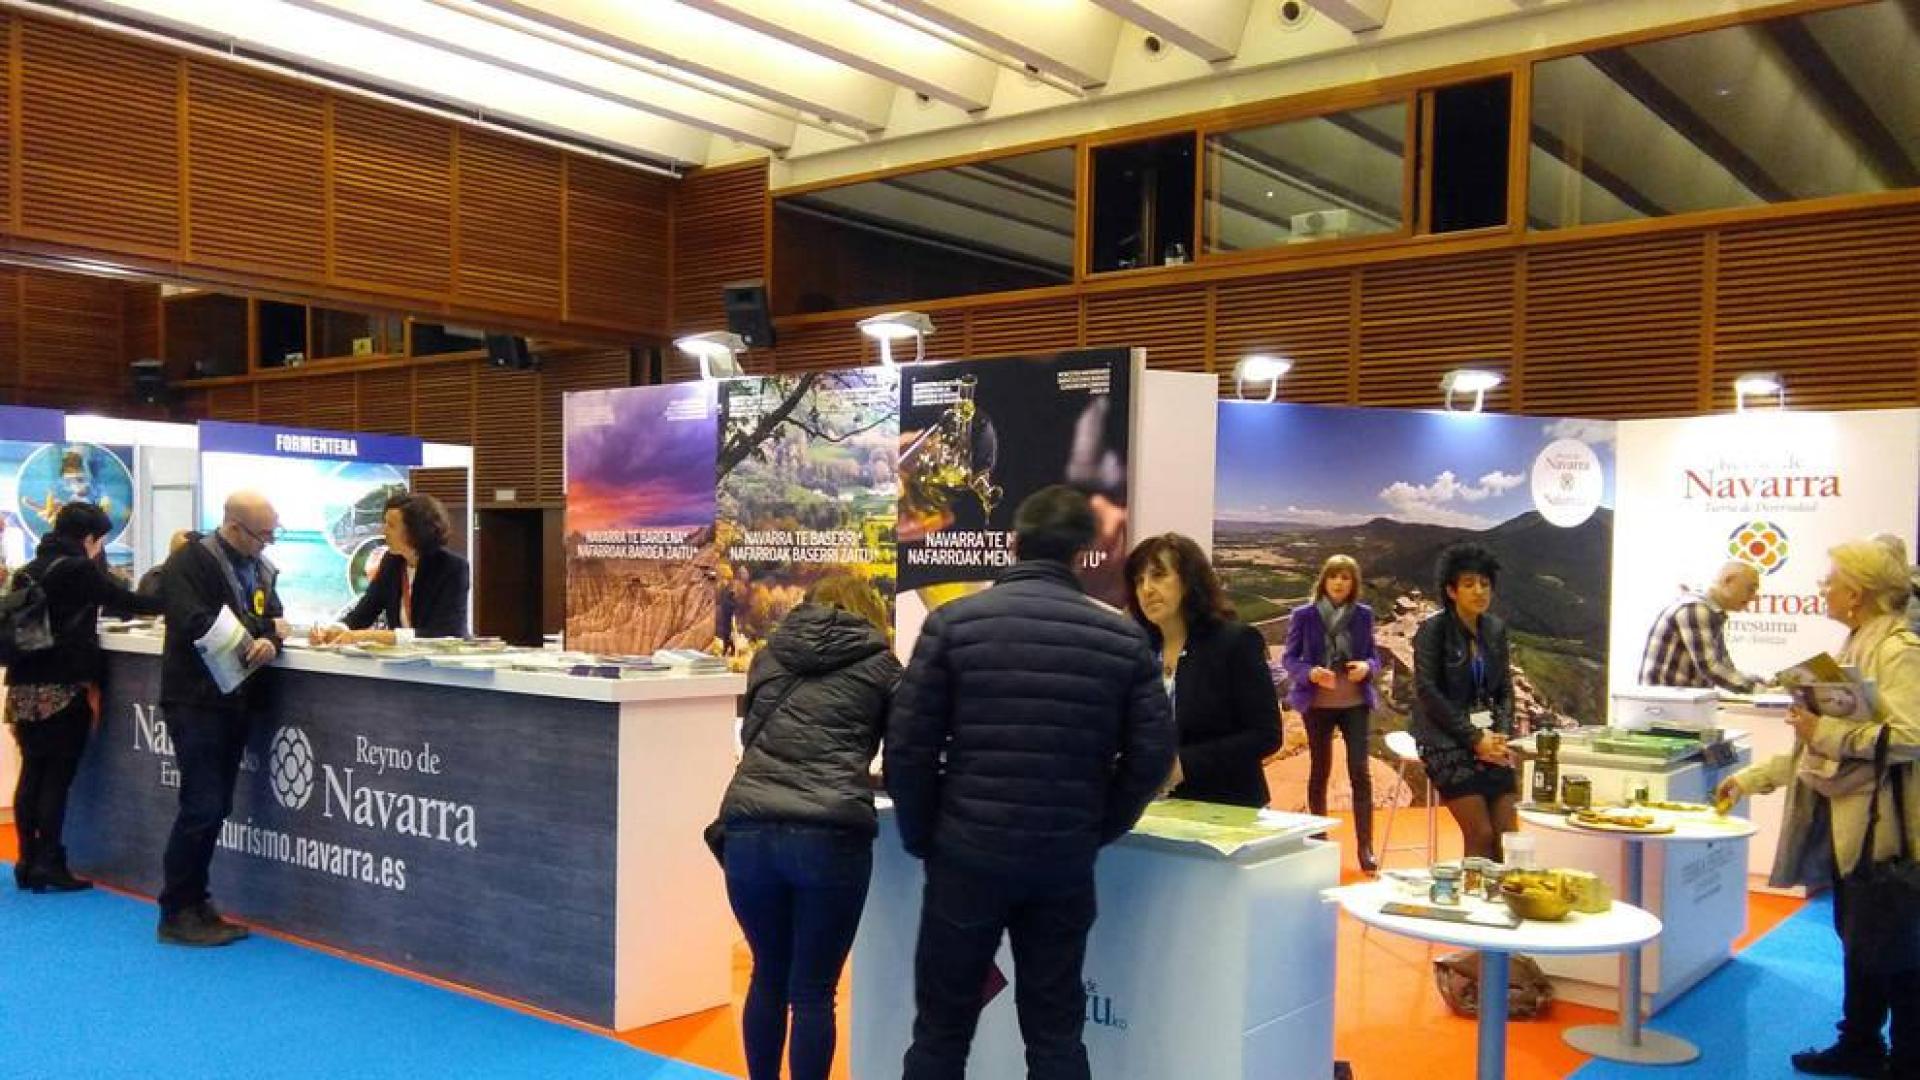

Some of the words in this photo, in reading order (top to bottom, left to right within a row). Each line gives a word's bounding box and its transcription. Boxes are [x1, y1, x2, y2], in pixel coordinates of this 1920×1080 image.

[276, 434, 358, 456] FORMENTERA
[1683, 469, 1842, 499] Navarra
[744, 530, 793, 545] NAVARRA
[795, 530, 808, 545] TE
[926, 530, 984, 547] NAVARRA
[988, 530, 1004, 546] TE
[907, 549, 983, 566] NAFARROAK
[356, 735, 413, 775] Reyno
[416, 742, 442, 775] de
[322, 763, 478, 848] Navarra
